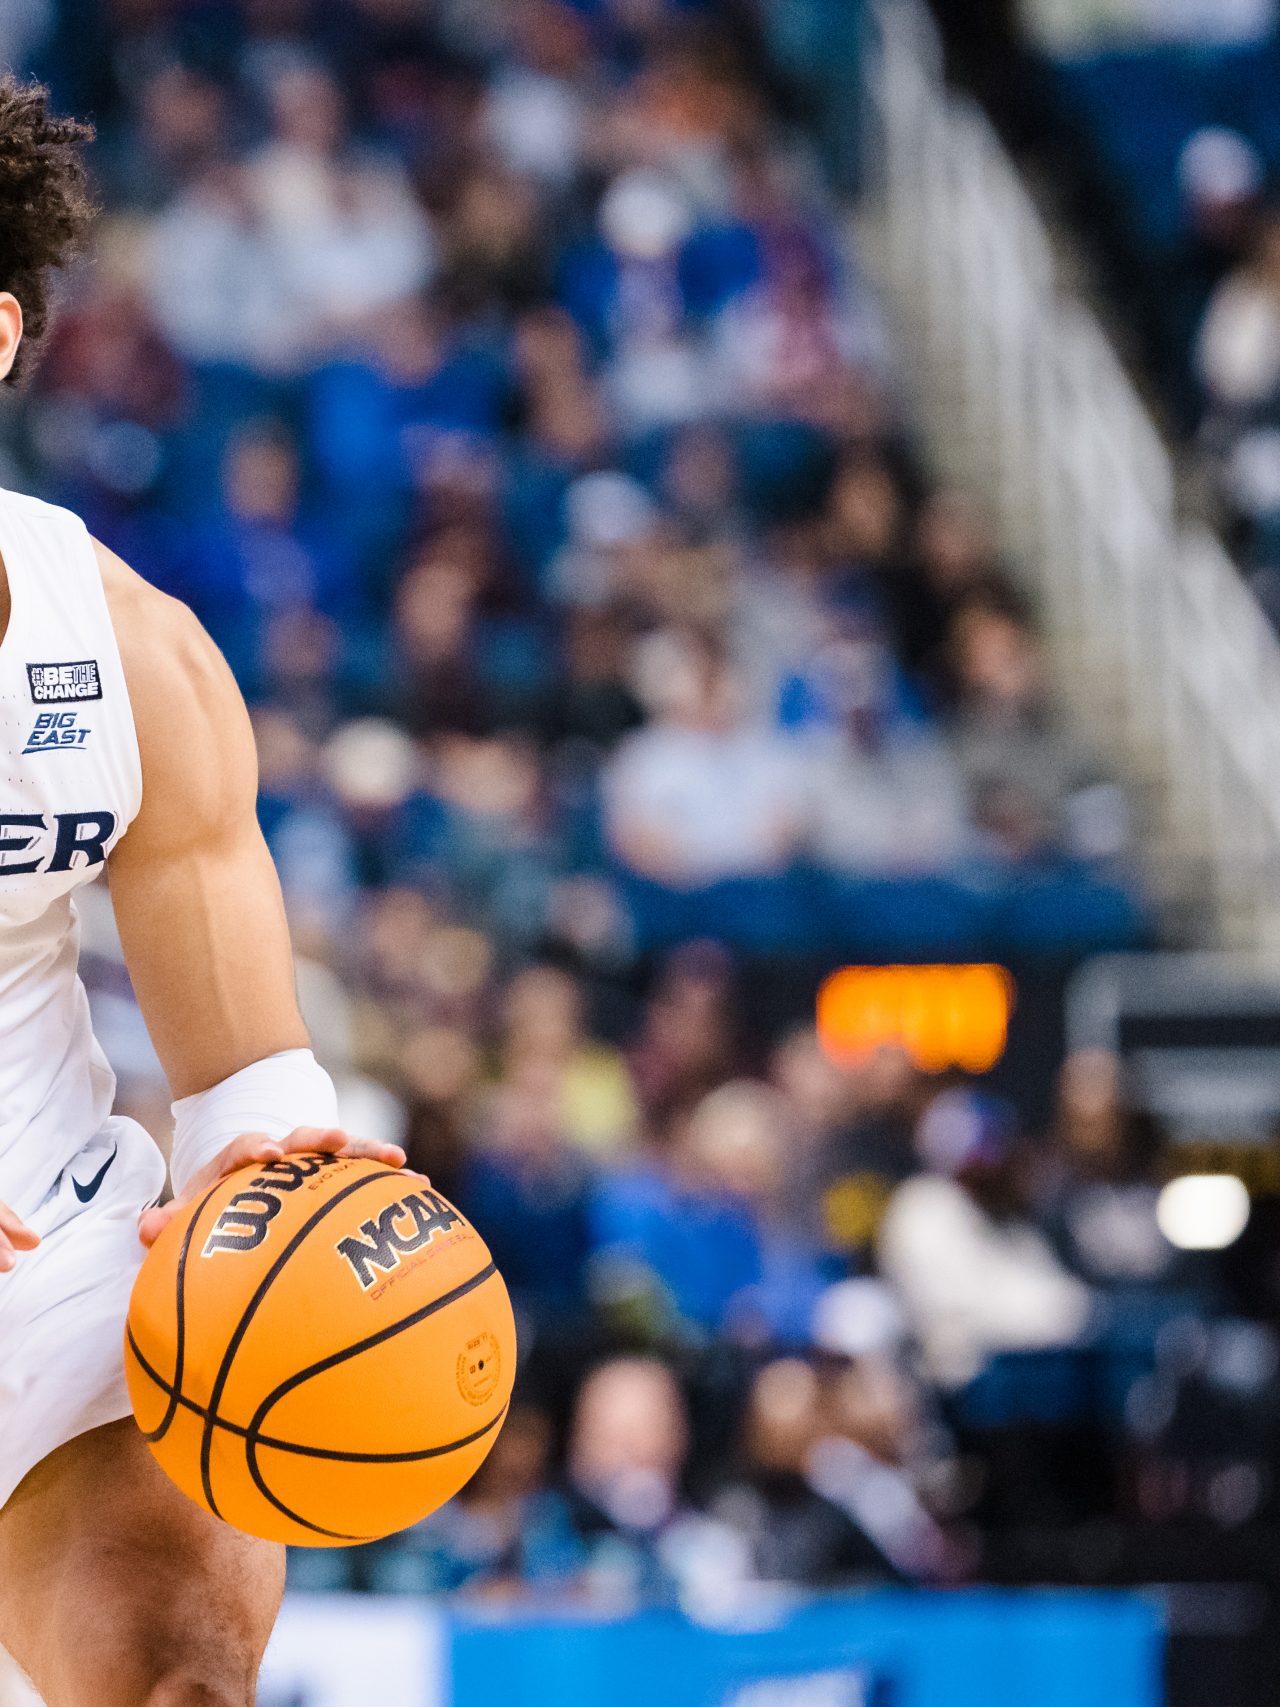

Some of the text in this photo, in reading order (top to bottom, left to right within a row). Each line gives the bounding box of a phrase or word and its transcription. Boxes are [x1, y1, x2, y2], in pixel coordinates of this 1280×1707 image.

[34, 682, 99, 699] CHANGE
[34, 712, 77, 729] BIG
[27, 729, 91, 745] EAST
[334, 1189, 466, 1292] NCAA
